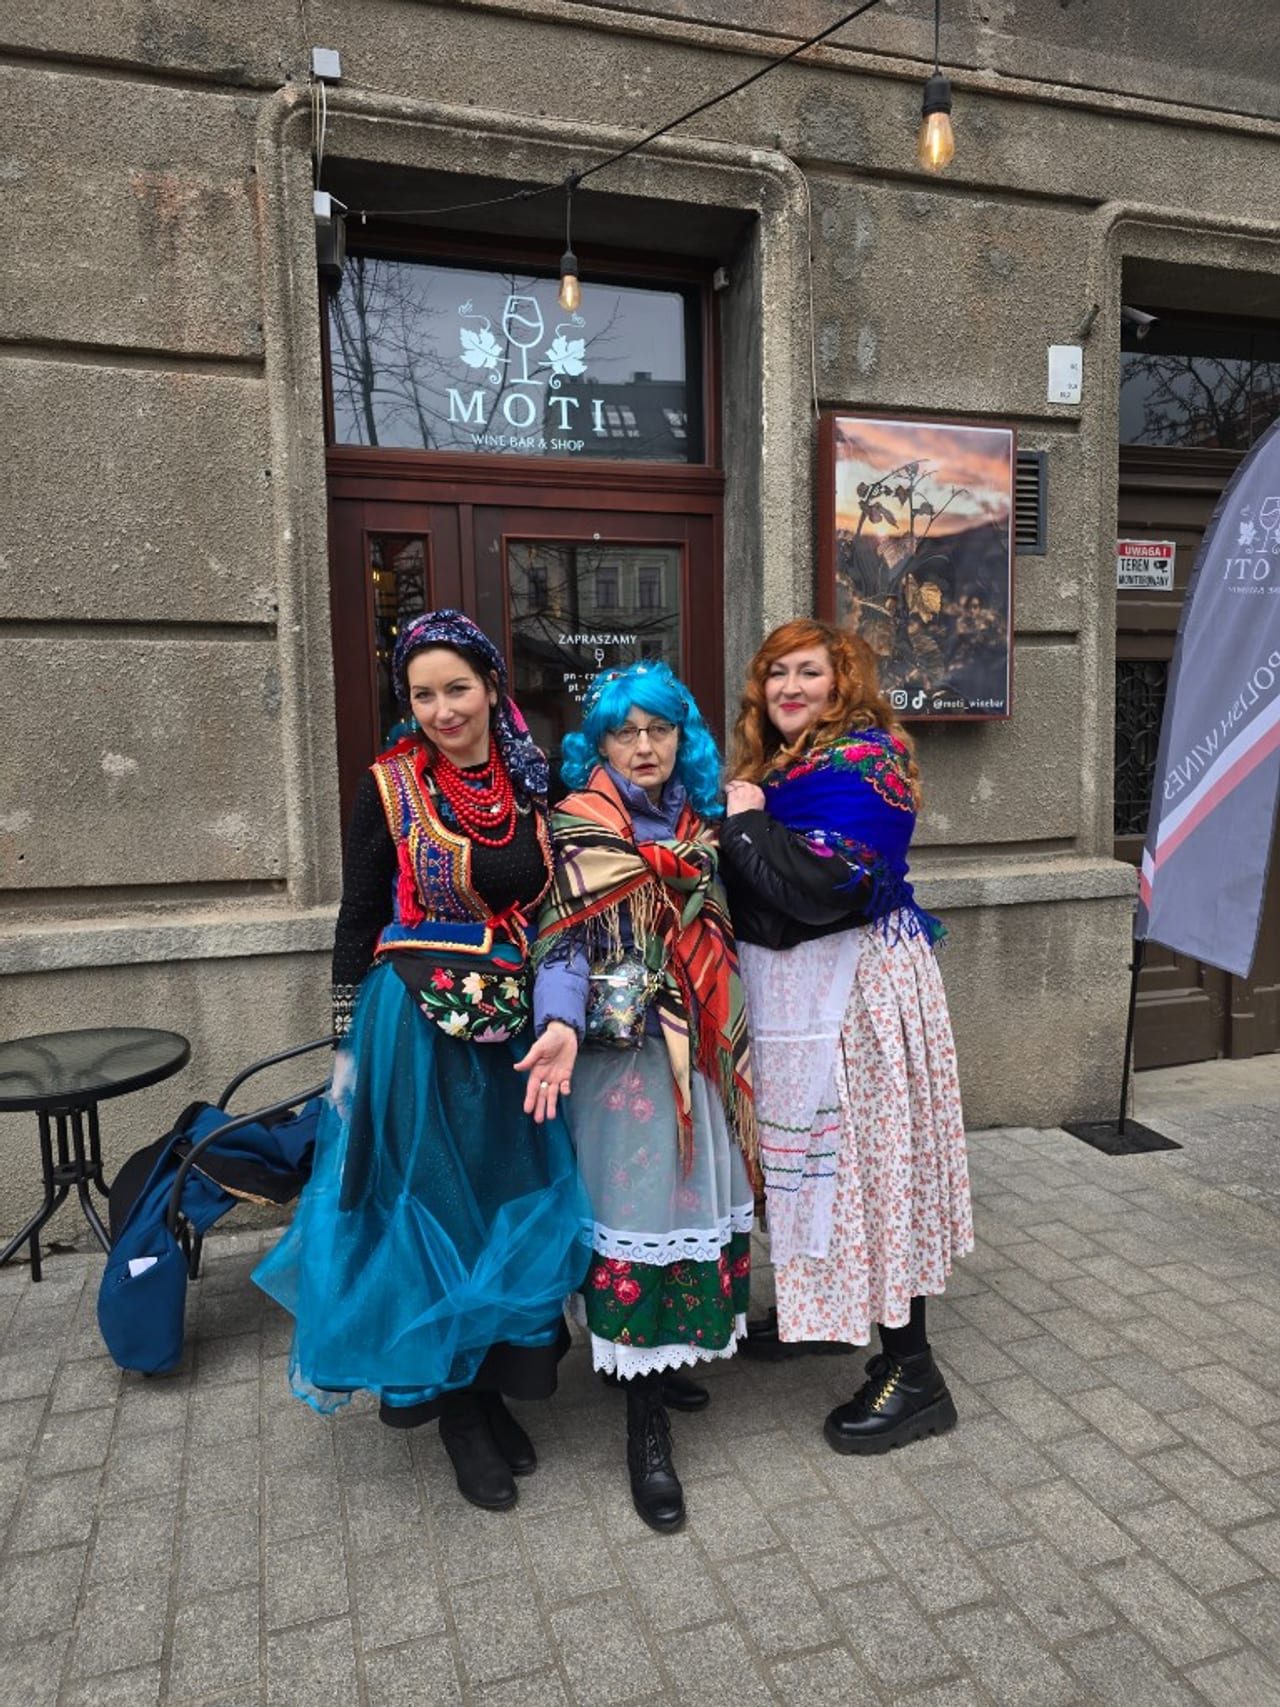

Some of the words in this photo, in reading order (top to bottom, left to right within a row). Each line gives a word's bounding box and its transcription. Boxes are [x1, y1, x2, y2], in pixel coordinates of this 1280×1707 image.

[445, 388, 606, 432] MOTI
[471, 434, 506, 447] WINE
[510, 436, 535, 448] BAR
[538, 438, 548, 449] &
[551, 438, 585, 451] SHOP
[1120, 558, 1150, 572] TEREN
[558, 633, 637, 645] ZAPRASZAMY
[563, 673, 576, 682] pn
[568, 683, 579, 693] pt
